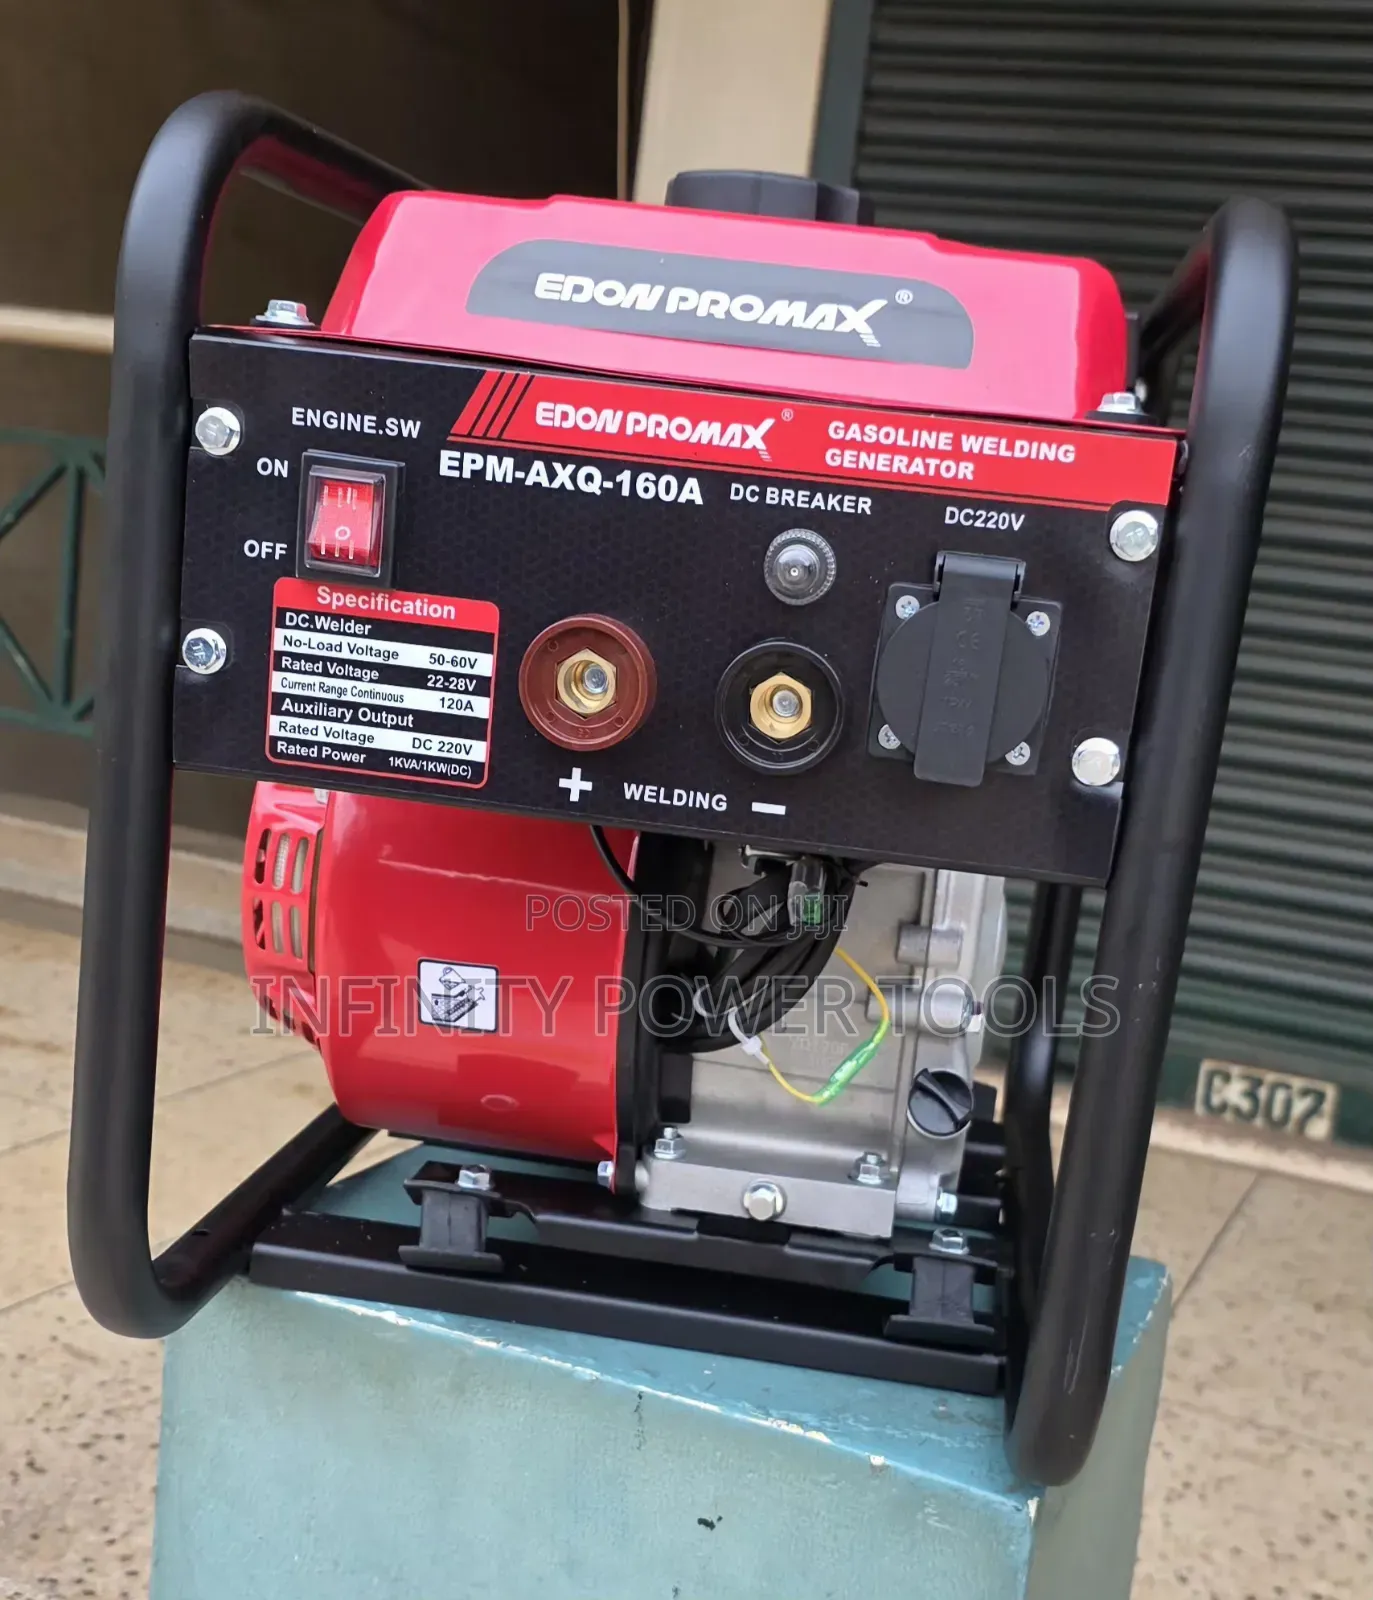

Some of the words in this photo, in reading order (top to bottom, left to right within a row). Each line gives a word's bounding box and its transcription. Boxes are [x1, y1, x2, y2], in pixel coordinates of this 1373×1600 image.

[534, 272, 664, 313] EDON
[665, 287, 888, 348] PROMAX
[291, 406, 422, 440] ENGINE.SW
[535, 401, 623, 434] EDON
[625, 411, 776, 462] PROMAX
[828, 420, 953, 451] GASOLINE
[961, 434, 1075, 463] WELDING
[256, 457, 289, 478] ON
[438, 449, 704, 505] EPM-AXQ-160A
[825, 448, 974, 480] GENERATOR
[729, 482, 760, 503] DC
[766, 487, 872, 514] BREAKER
[944, 506, 1025, 531] DC220V
[243, 538, 288, 560] OFF
[316, 586, 456, 620] Specification
[285, 612, 372, 636] DC.Welder
[283, 635, 342, 653] No-Load
[347, 642, 399, 662] Voltage
[428, 653, 478, 670] 50-60V
[281, 656, 323, 673] Rated
[327, 662, 379, 682] Voltage
[427, 674, 477, 692] 22-28V
[280, 677, 316, 692] Current
[318, 682, 348, 698] Range
[350, 685, 404, 703] Continuous
[439, 697, 475, 713] 120A
[281, 698, 353, 723] Auxiliary
[358, 707, 414, 728] Output
[278, 721, 319, 736] Rated
[323, 726, 375, 745] Voltage
[412, 737, 433, 751] DC
[437, 741, 473, 756] 220V
[277, 741, 318, 758] Rated
[321, 746, 366, 763] Power
[388, 756, 472, 779] 1KVA/1KW(DC)
[623, 782, 728, 811] WELDING
[1205, 1069, 1326, 1134] C307
